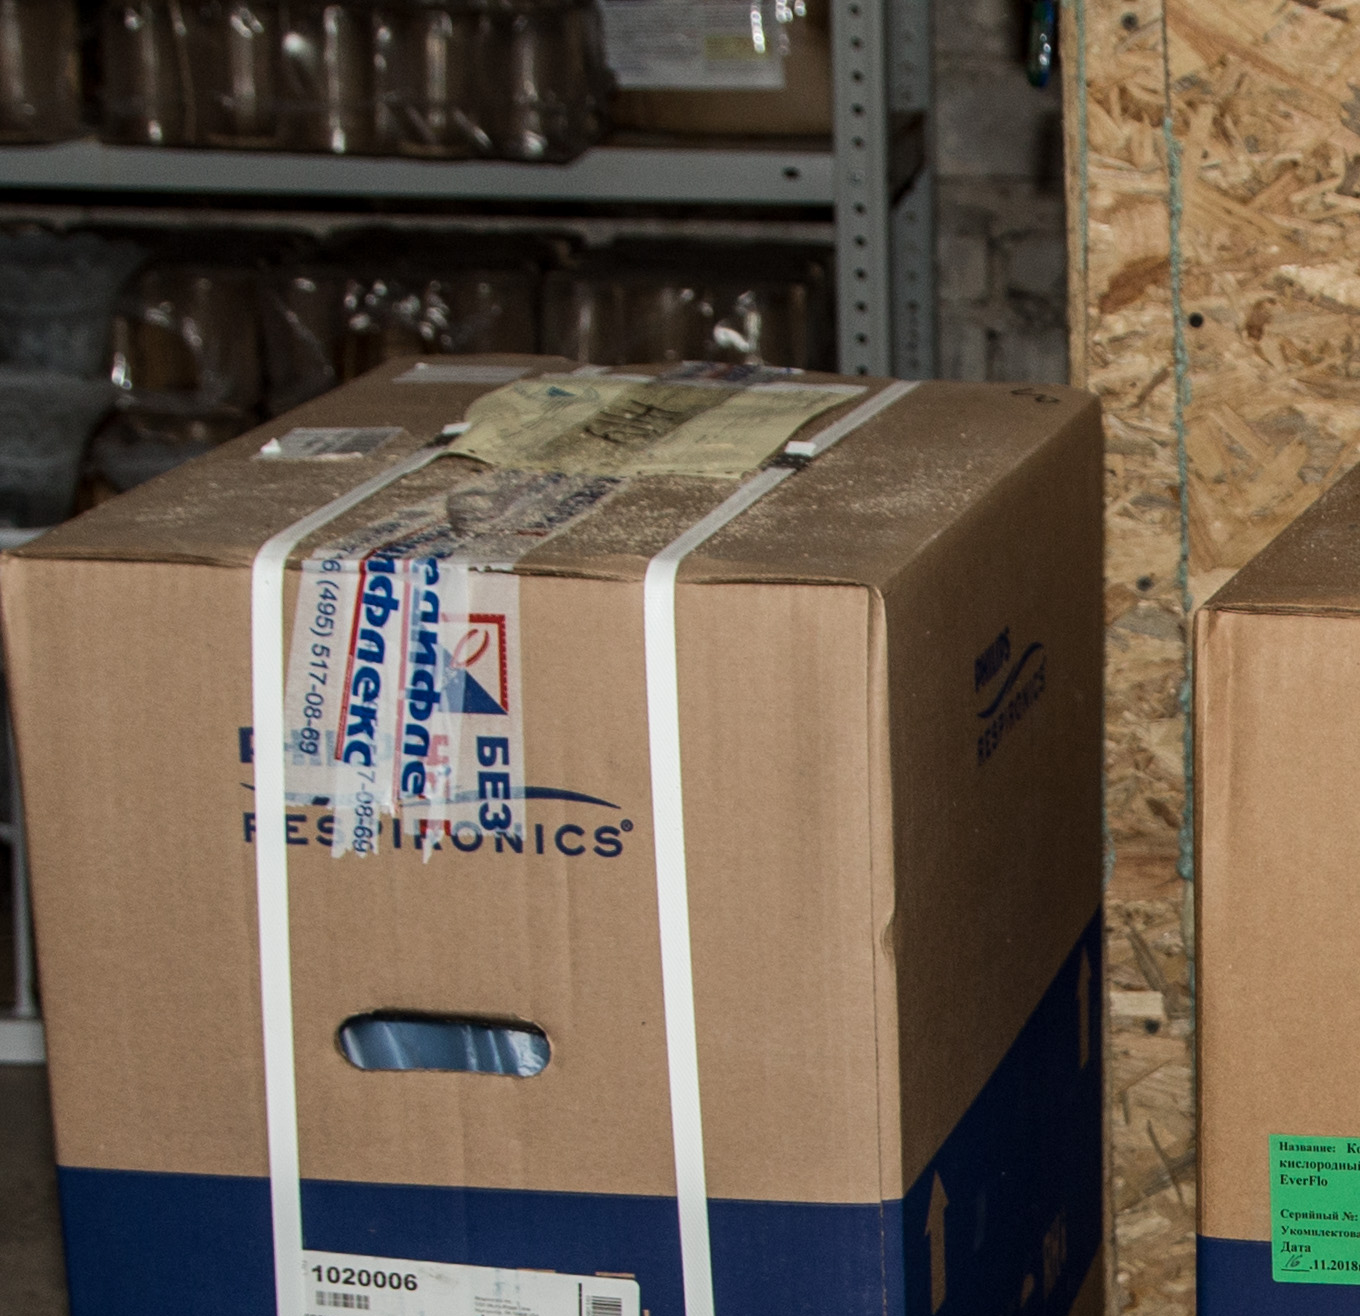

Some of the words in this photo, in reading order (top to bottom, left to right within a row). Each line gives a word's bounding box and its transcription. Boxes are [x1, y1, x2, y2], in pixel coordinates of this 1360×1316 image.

[310, 580, 340, 638] (495)
[299, 643, 331, 756] 517-08-69
[476, 735, 513, 832] БЕЗ
[1278, 1141, 1337, 1154] Название:
[1279, 1175, 1328, 1188] EverFlo
[1280, 1208, 1340, 1223] Серийный
[1280, 1241, 1312, 1254] Дата
[311, 1264, 418, 1292] 1020006
